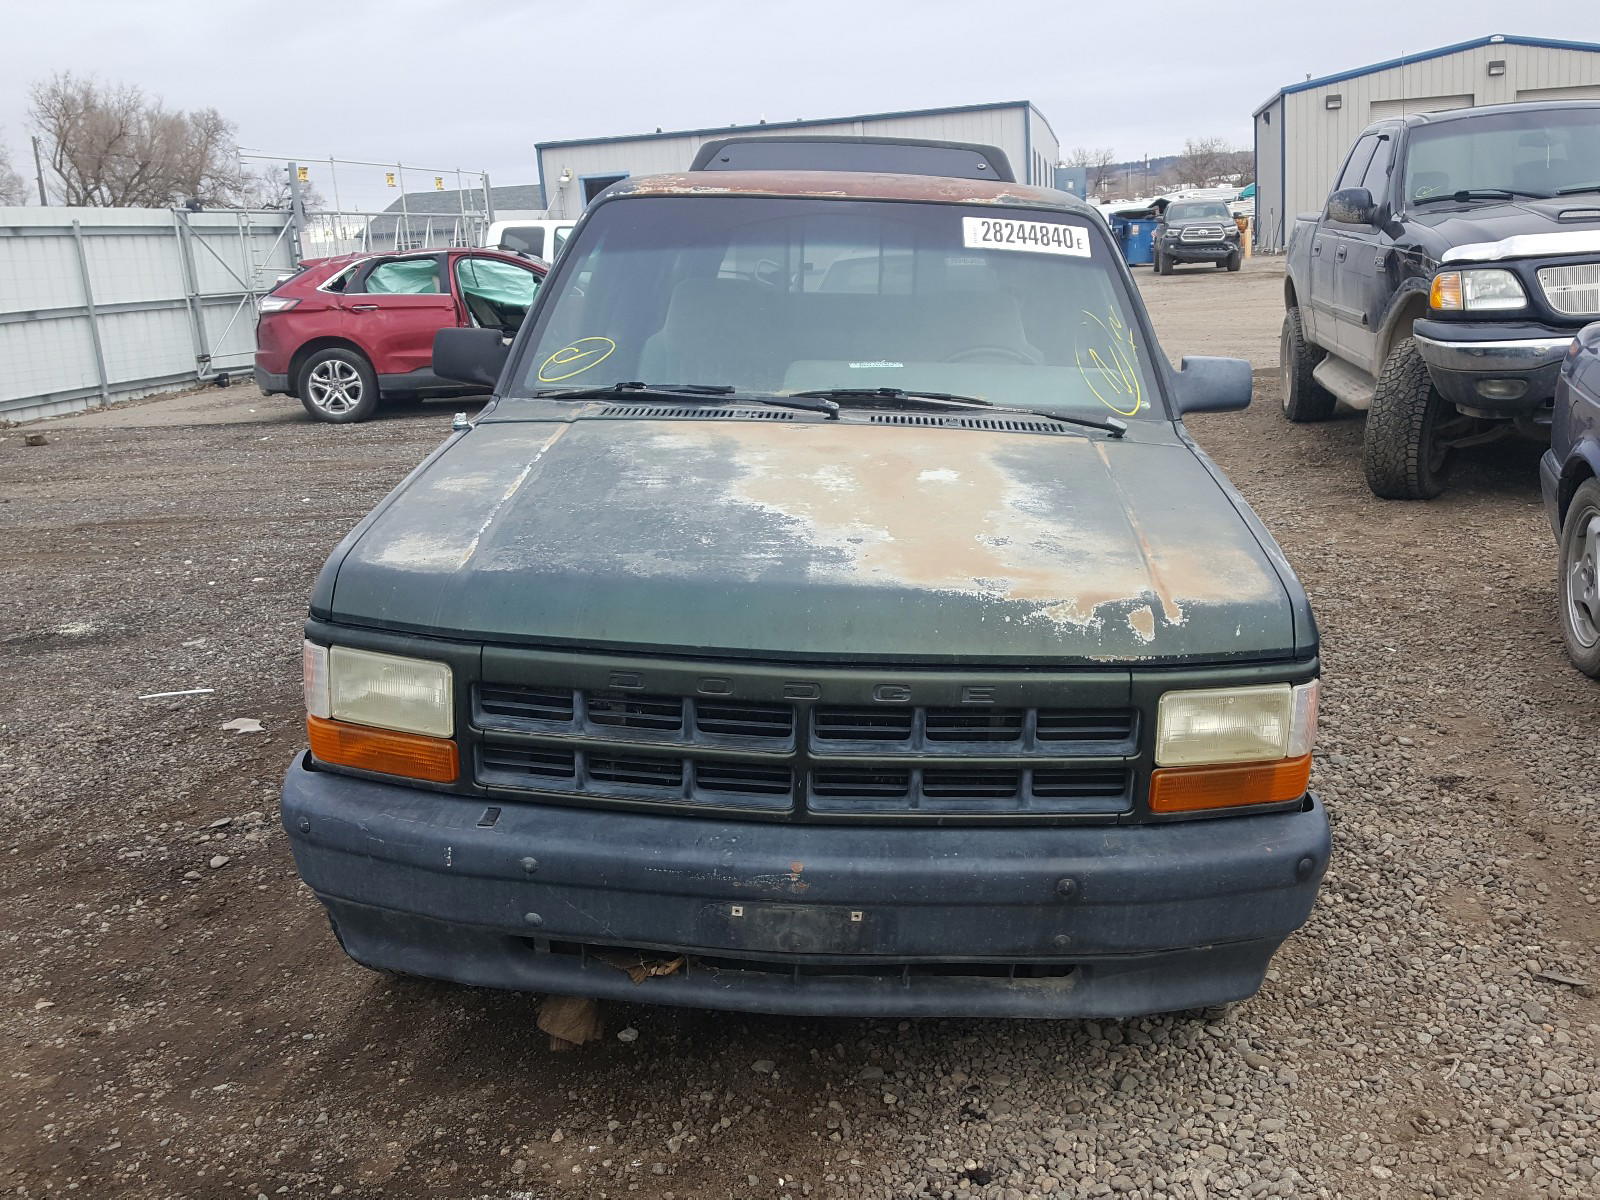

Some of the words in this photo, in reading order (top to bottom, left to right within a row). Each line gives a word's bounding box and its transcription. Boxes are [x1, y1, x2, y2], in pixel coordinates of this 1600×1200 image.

[981, 220, 1074, 249] 28244840
[1077, 238, 1084, 250] E
[608, 670, 997, 703] DODGE
